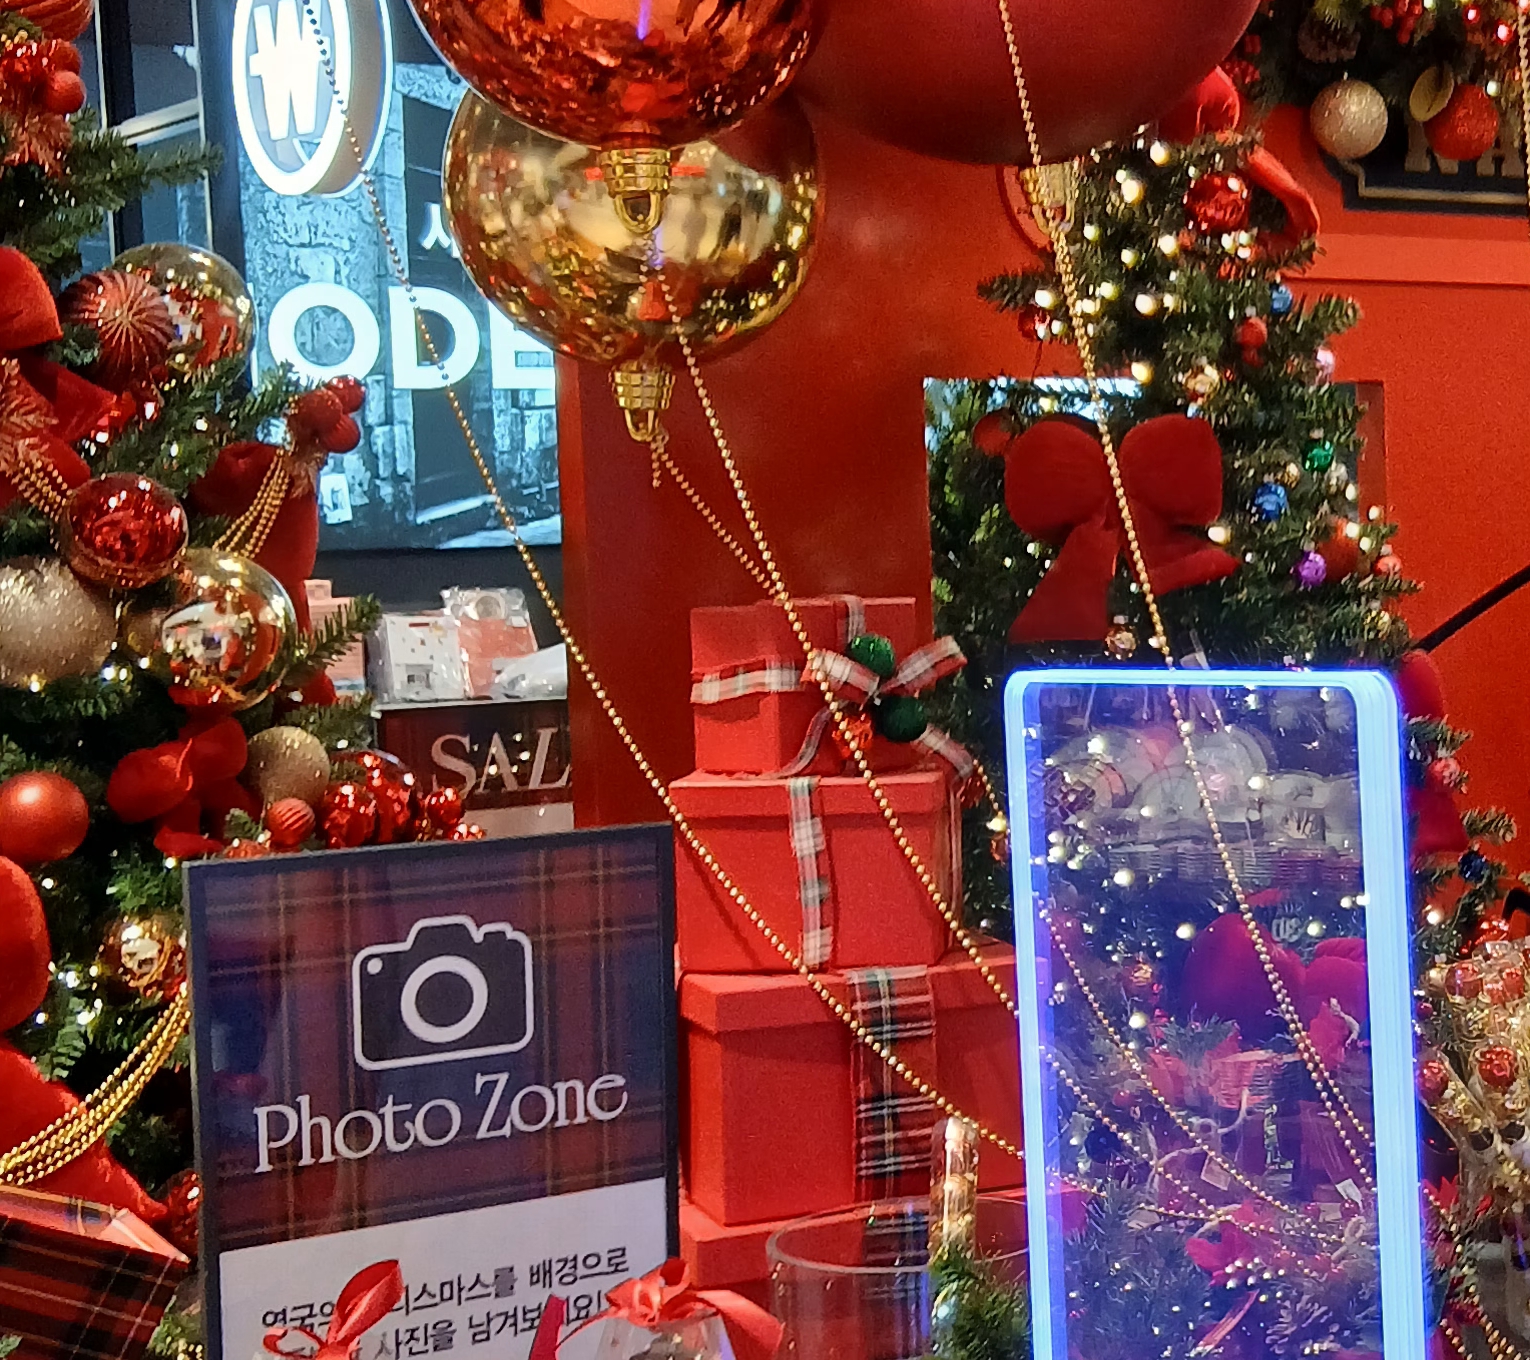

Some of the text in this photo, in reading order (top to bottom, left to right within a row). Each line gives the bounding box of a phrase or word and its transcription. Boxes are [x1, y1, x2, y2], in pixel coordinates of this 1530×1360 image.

[248, 282, 556, 390] ODE
[253, 1071, 629, 1174] Photo Zone
[390, 1265, 518, 1317] 스마스를
[529, 1246, 630, 1290] 배경으로
